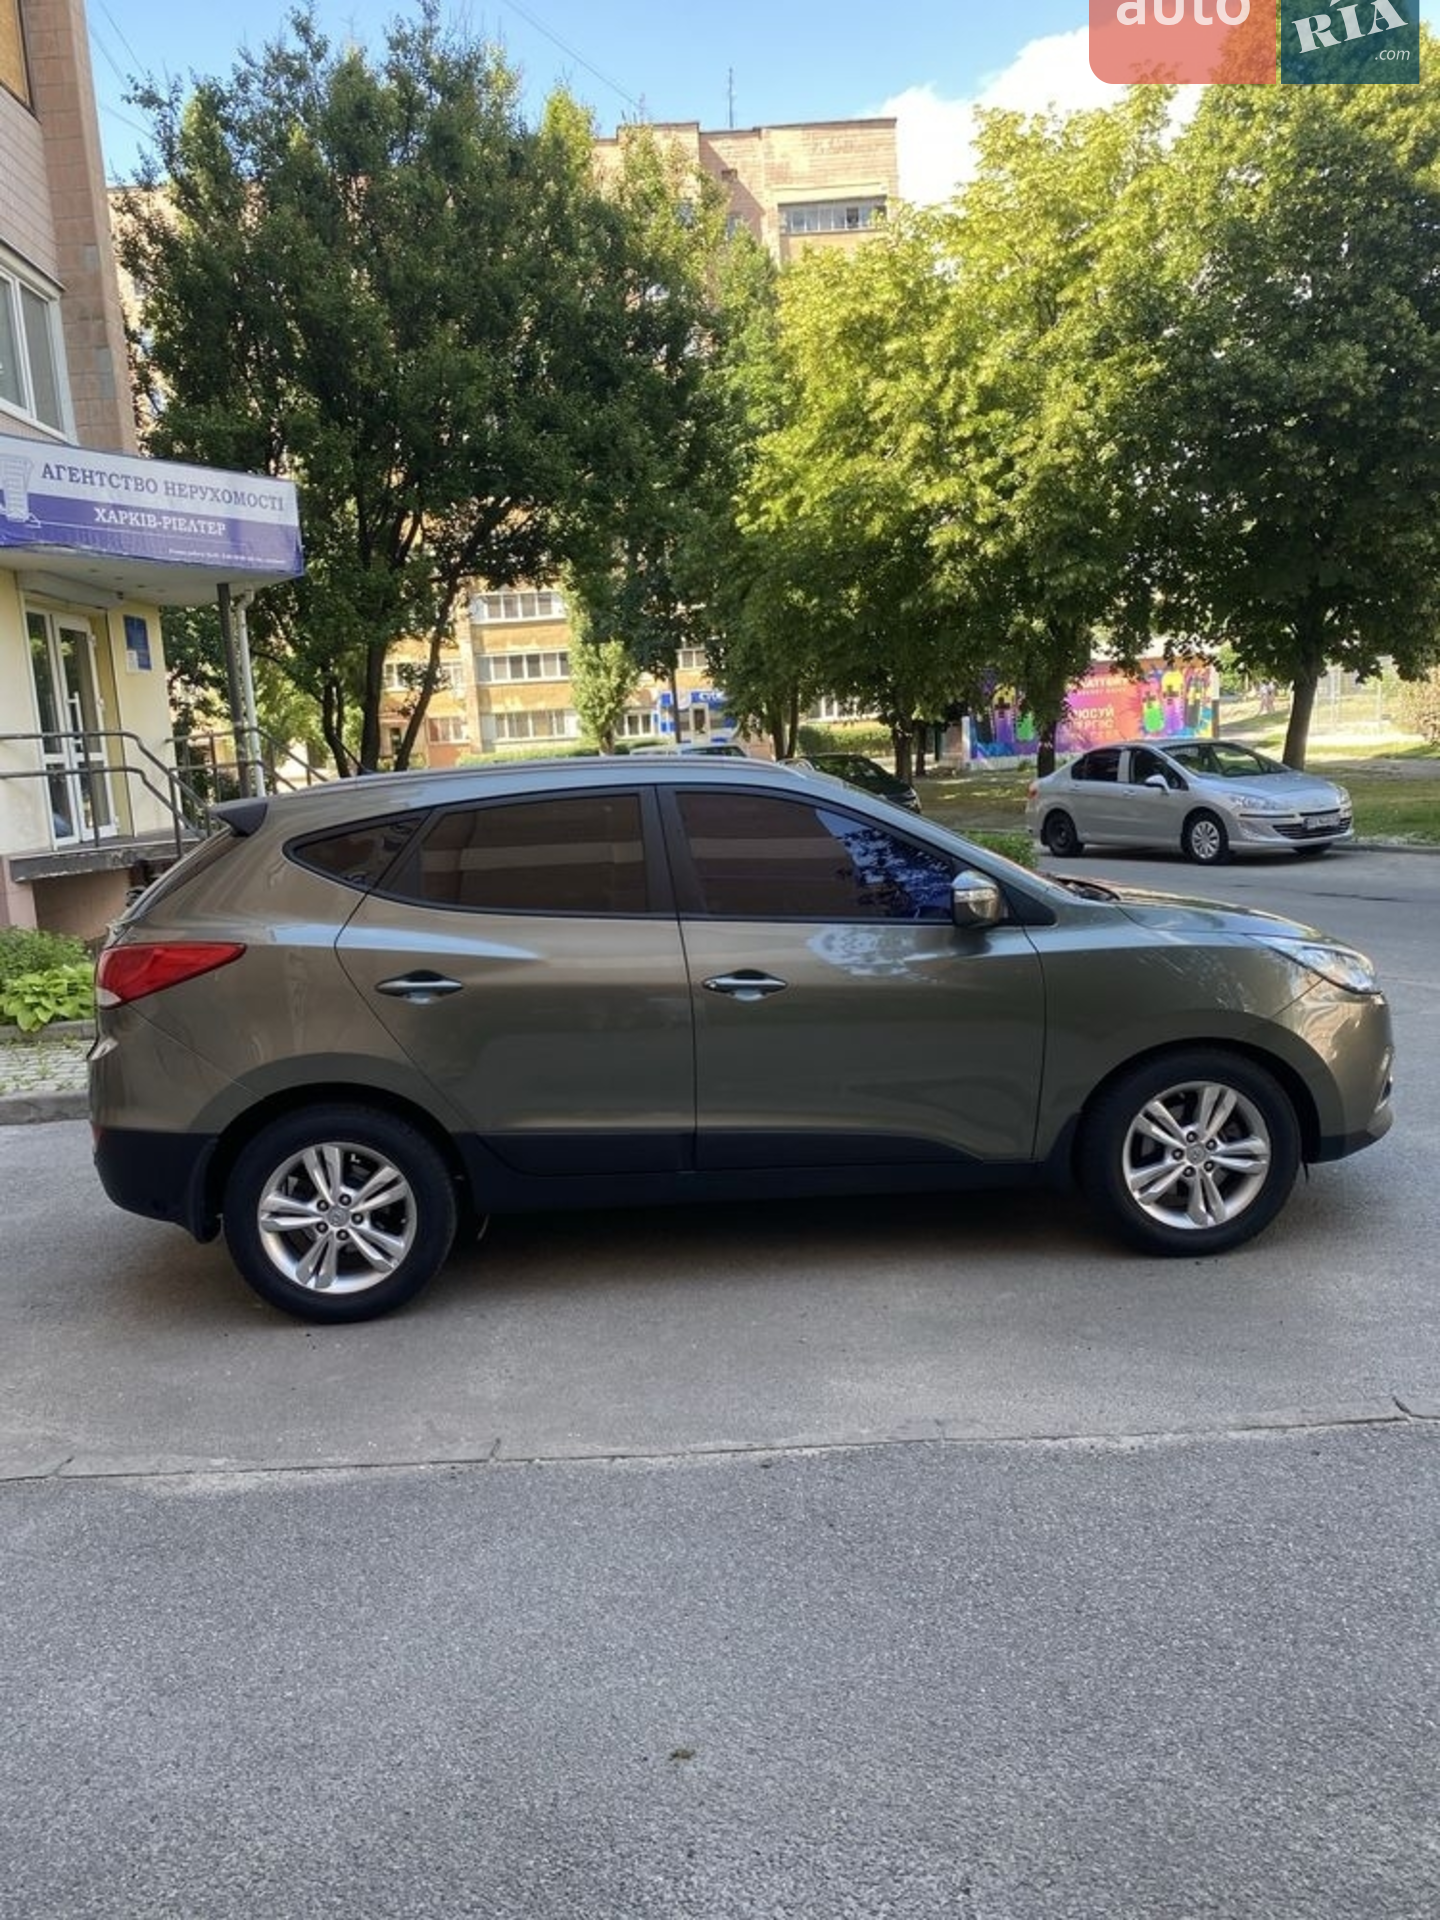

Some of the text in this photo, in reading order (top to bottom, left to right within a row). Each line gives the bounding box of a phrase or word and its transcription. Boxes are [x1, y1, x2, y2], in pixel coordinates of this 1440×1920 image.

[42, 462, 283, 512] АГЕНТСТВО НЕРУХОМОСТІ
[94, 507, 226, 536] ХАРКІВ-РІЕЛТЕР
